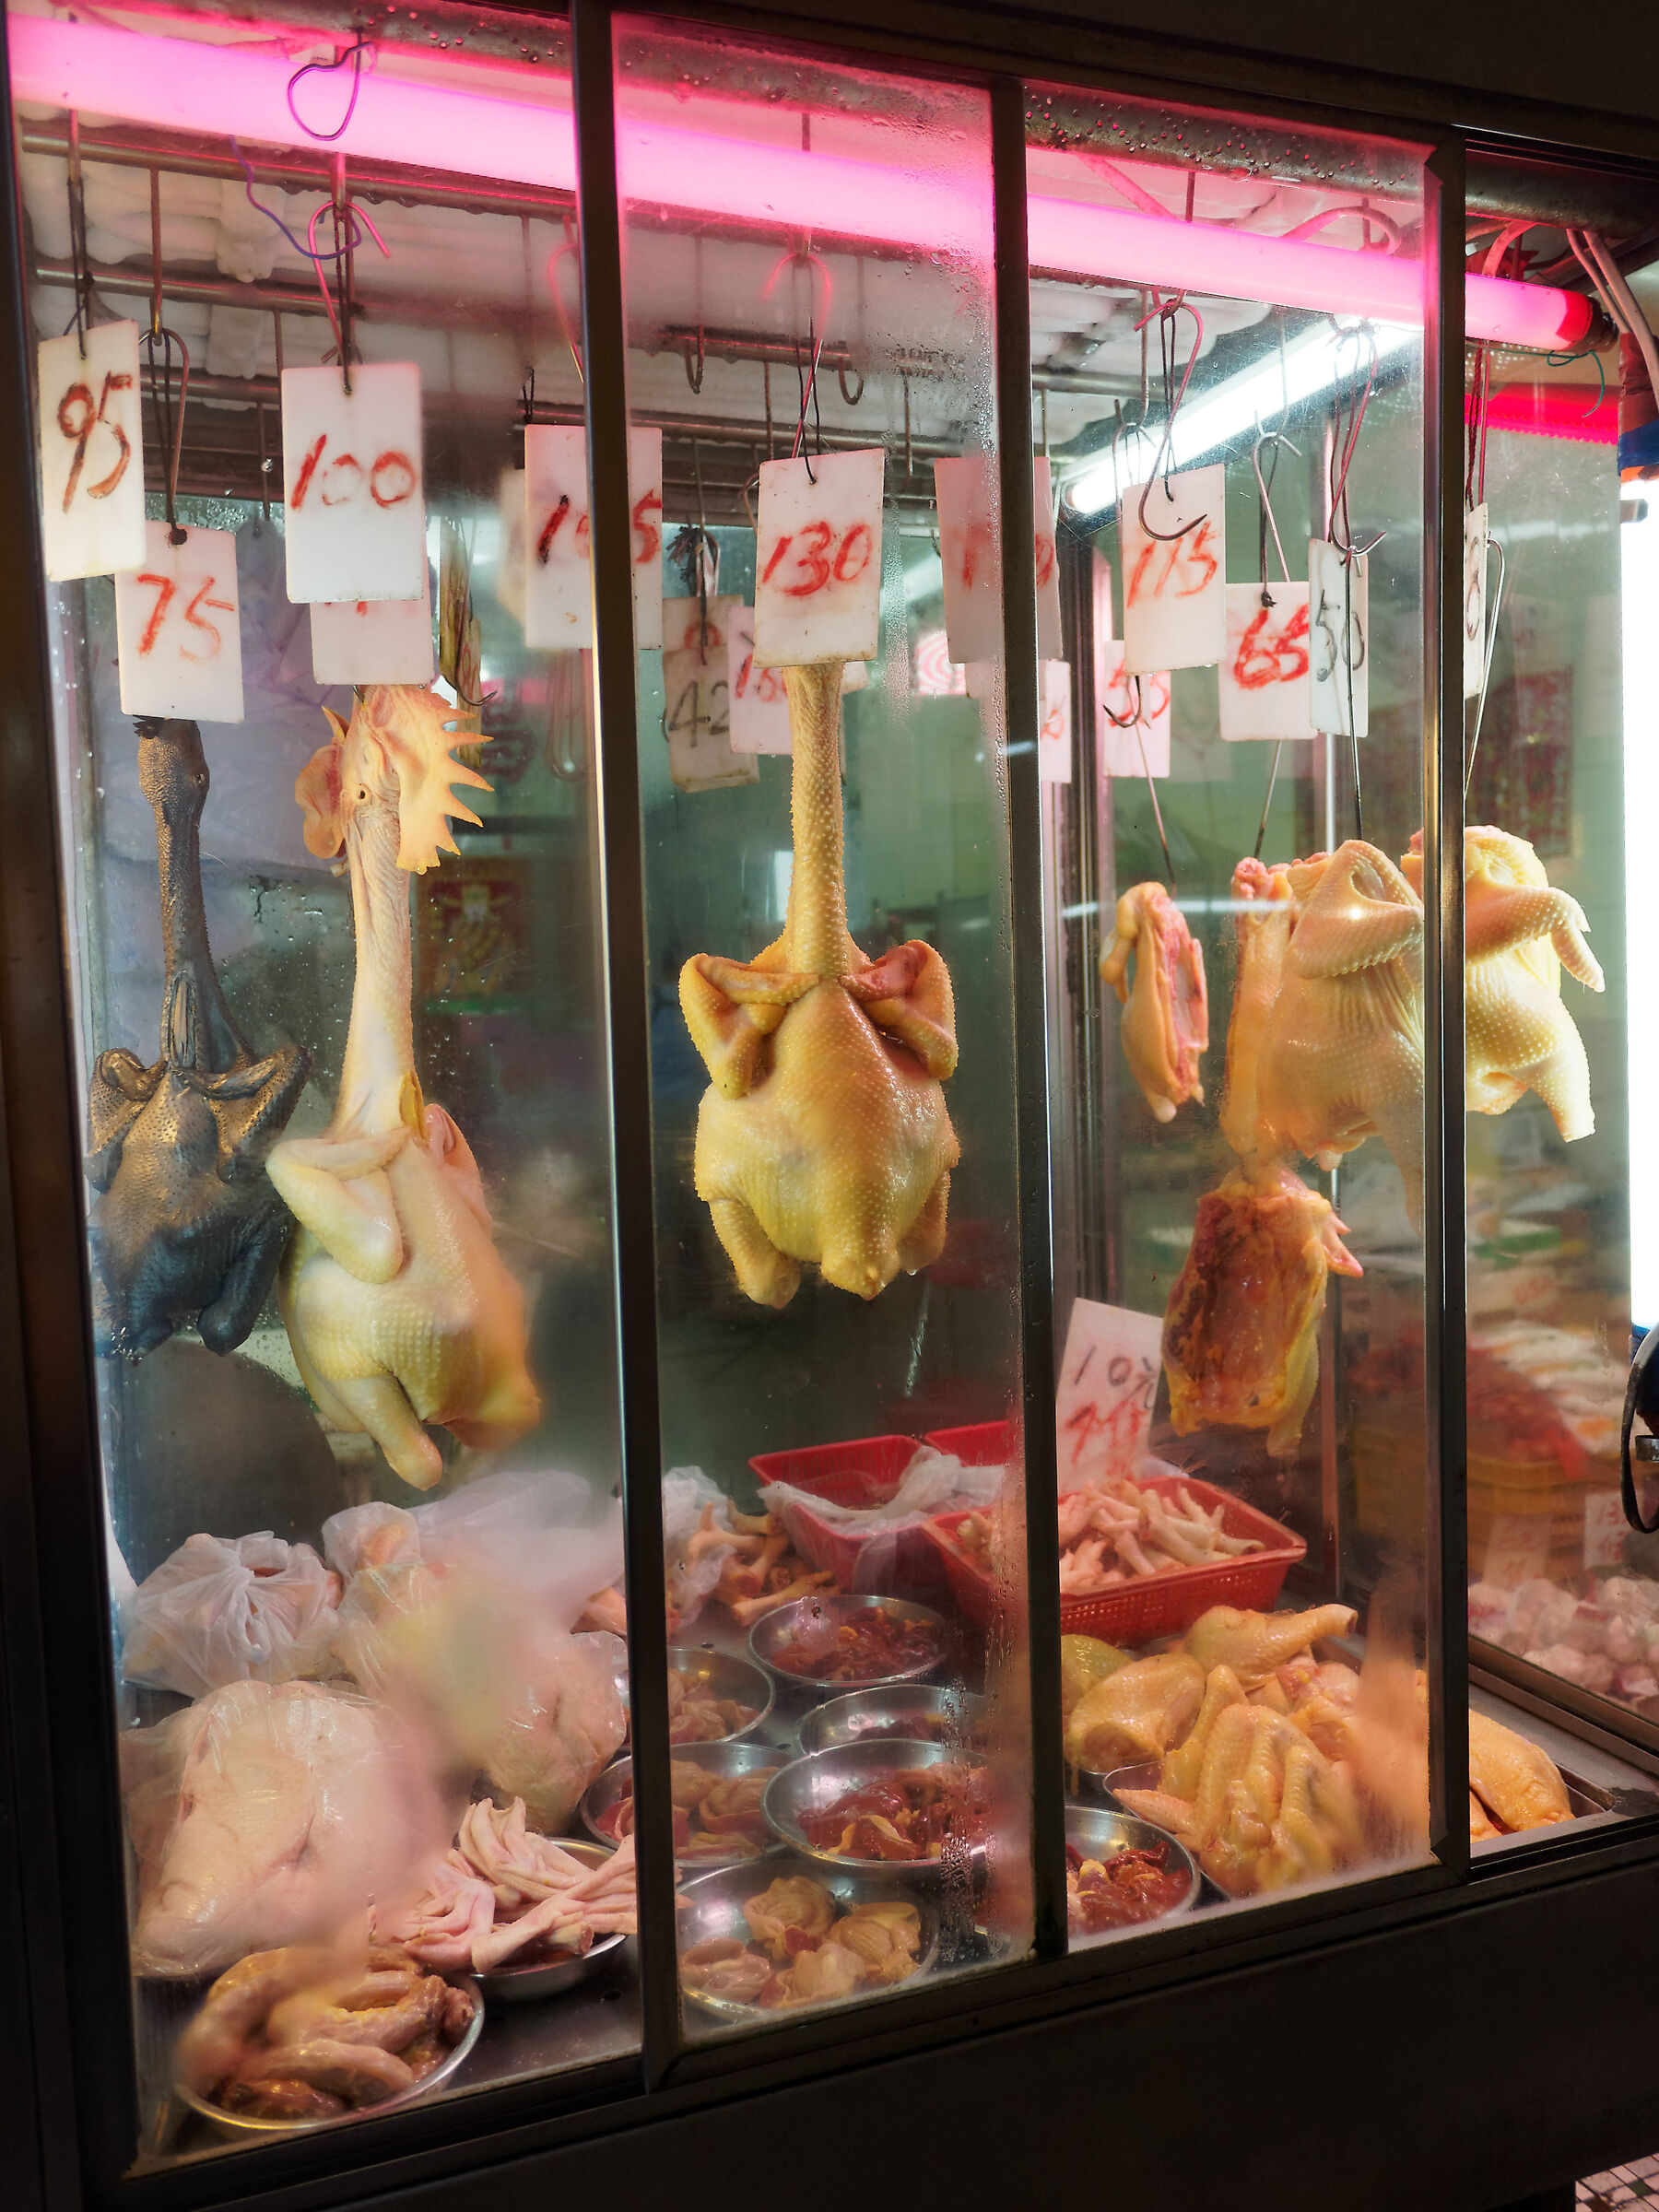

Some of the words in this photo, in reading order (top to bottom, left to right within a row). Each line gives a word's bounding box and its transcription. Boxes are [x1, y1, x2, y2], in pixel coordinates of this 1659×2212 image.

[57, 371, 133, 513] 95
[290, 434, 417, 512] 100
[761, 521, 873, 597] 130
[1126, 520, 1220, 610] 115
[137, 573, 235, 665] 75
[1315, 588, 1365, 682] 50
